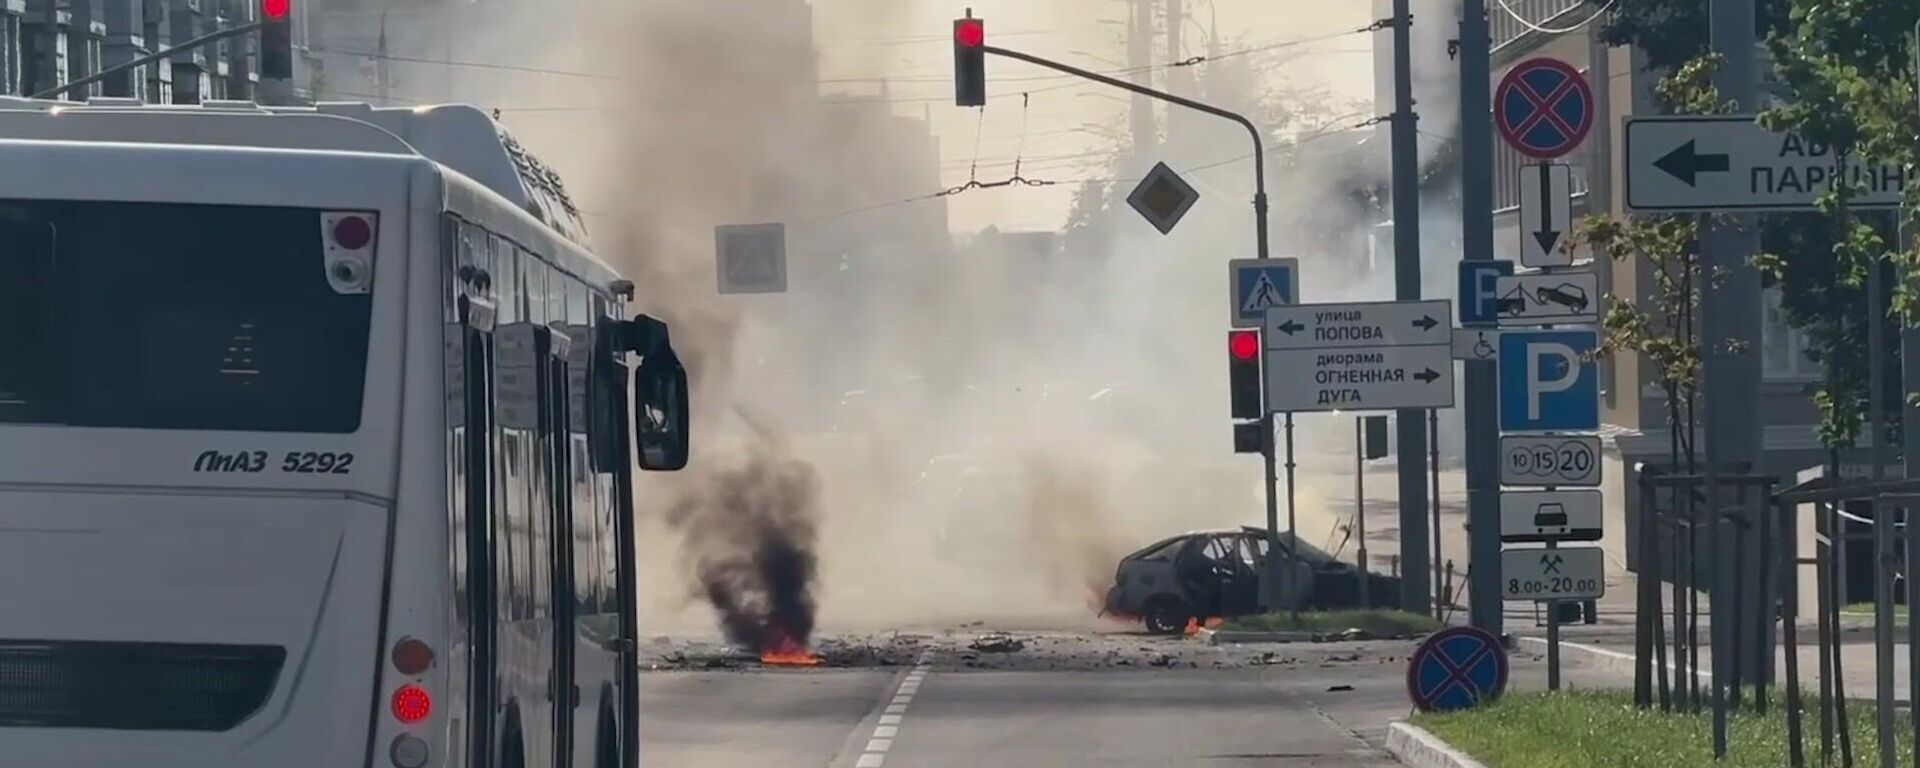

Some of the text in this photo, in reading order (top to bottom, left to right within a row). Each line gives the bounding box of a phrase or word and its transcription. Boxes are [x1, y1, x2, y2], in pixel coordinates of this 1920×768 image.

[1315, 311, 1361, 325] улица
[1315, 326, 1384, 341] ПОПОВА
[1316, 352, 1384, 366] диорама
[1315, 369, 1405, 384] ОГНЕННАЯ
[1526, 342, 1580, 420] P
[1317, 388, 1362, 405] ДУГА
[281, 452, 354, 474] 5292
[1513, 449, 1590, 471] 10 15 20
